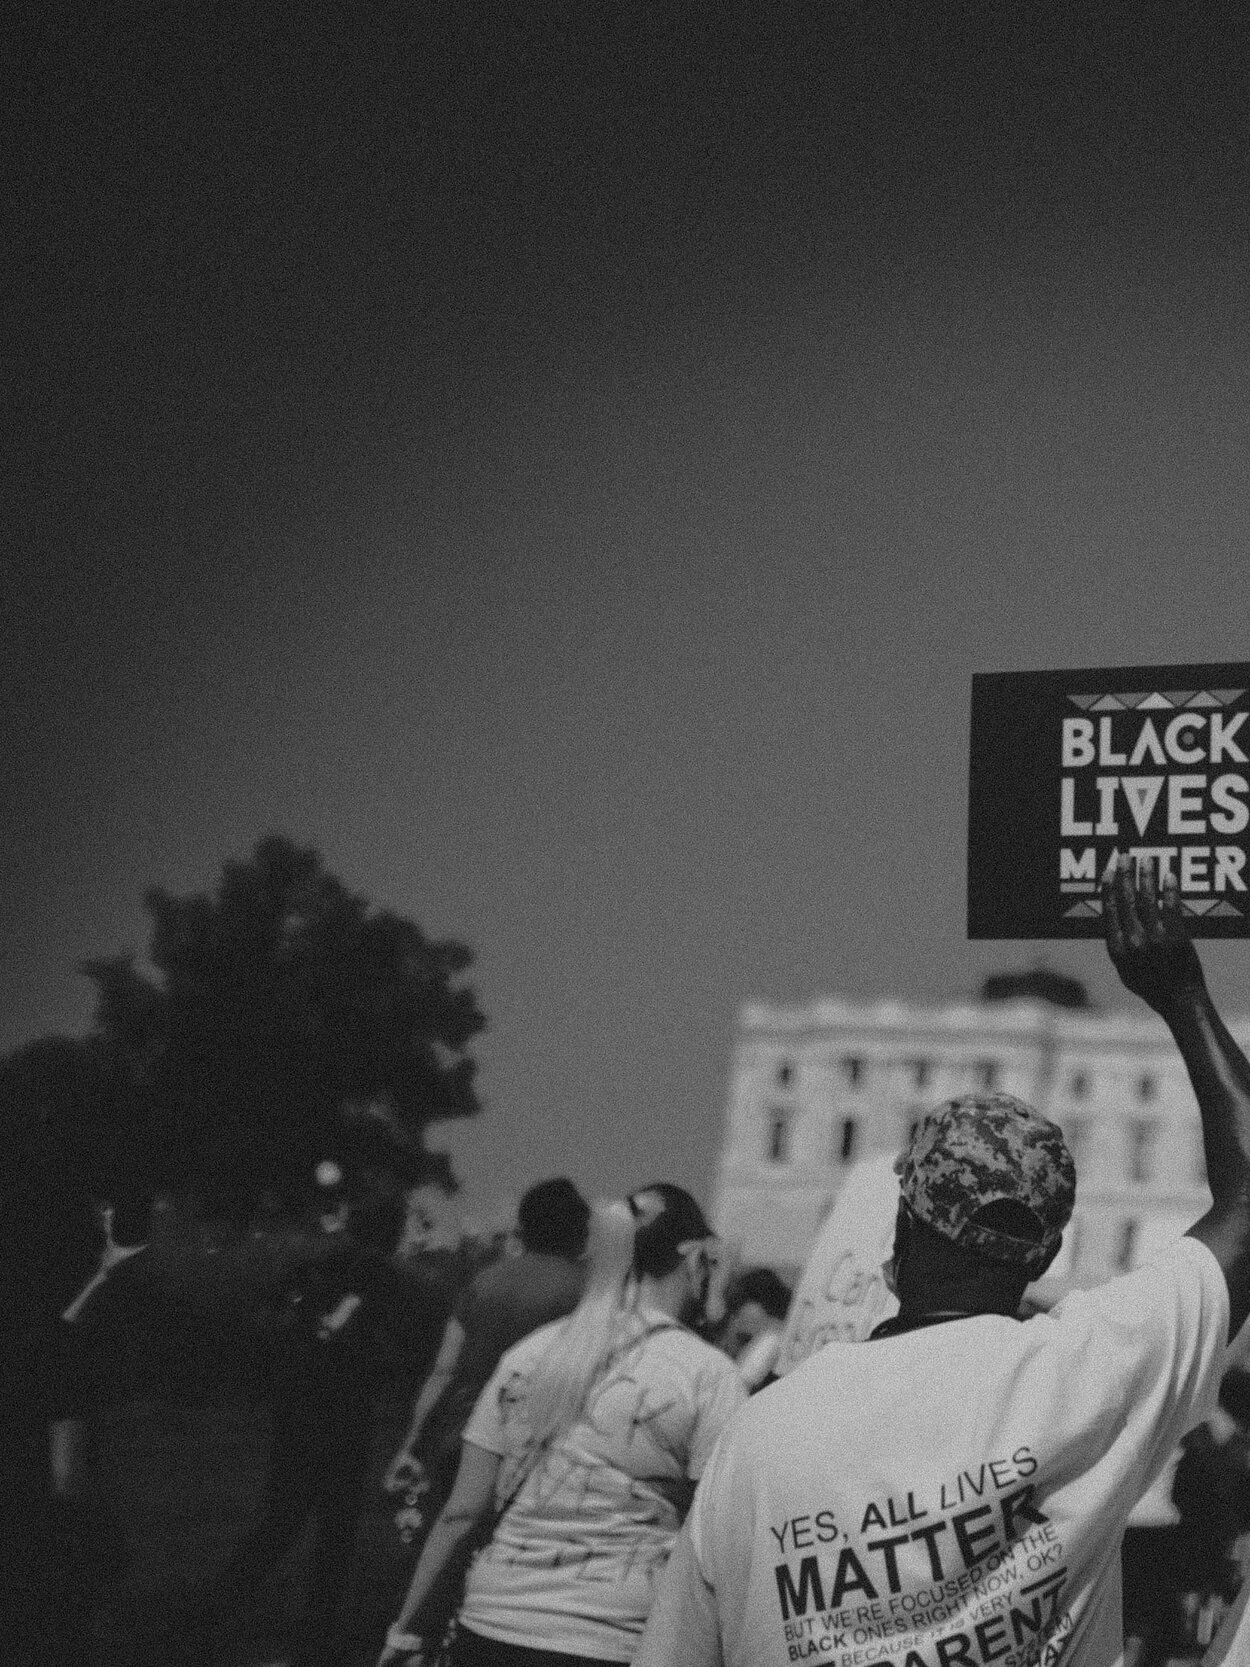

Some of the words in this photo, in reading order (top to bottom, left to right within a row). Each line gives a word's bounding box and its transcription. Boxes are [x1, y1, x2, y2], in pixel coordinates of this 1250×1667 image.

[1062, 712, 1250, 767] BLACK
[1060, 773, 1250, 837] LIVES
[770, 1510, 849, 1554] YES,
[860, 1491, 928, 1533] ALL
[940, 1446, 1038, 1510] LIVES
[775, 1483, 1050, 1621] MATTER
[784, 1618, 815, 1642] BUT
[821, 1603, 884, 1630] WE'RE
[888, 1568, 982, 1615] FOCUSED
[987, 1546, 1015, 1571] ON
[1019, 1523, 1058, 1554] THE
[788, 1633, 847, 1662] BLACK
[853, 1618, 909, 1645] ONES
[911, 1595, 970, 1628] RIGHT
[974, 1566, 1024, 1599] NOW,
[1027, 1544, 1063, 1572] OK?
[841, 1634, 924, 1667] BECAUSE
[969, 1591, 1013, 1621] VERY
